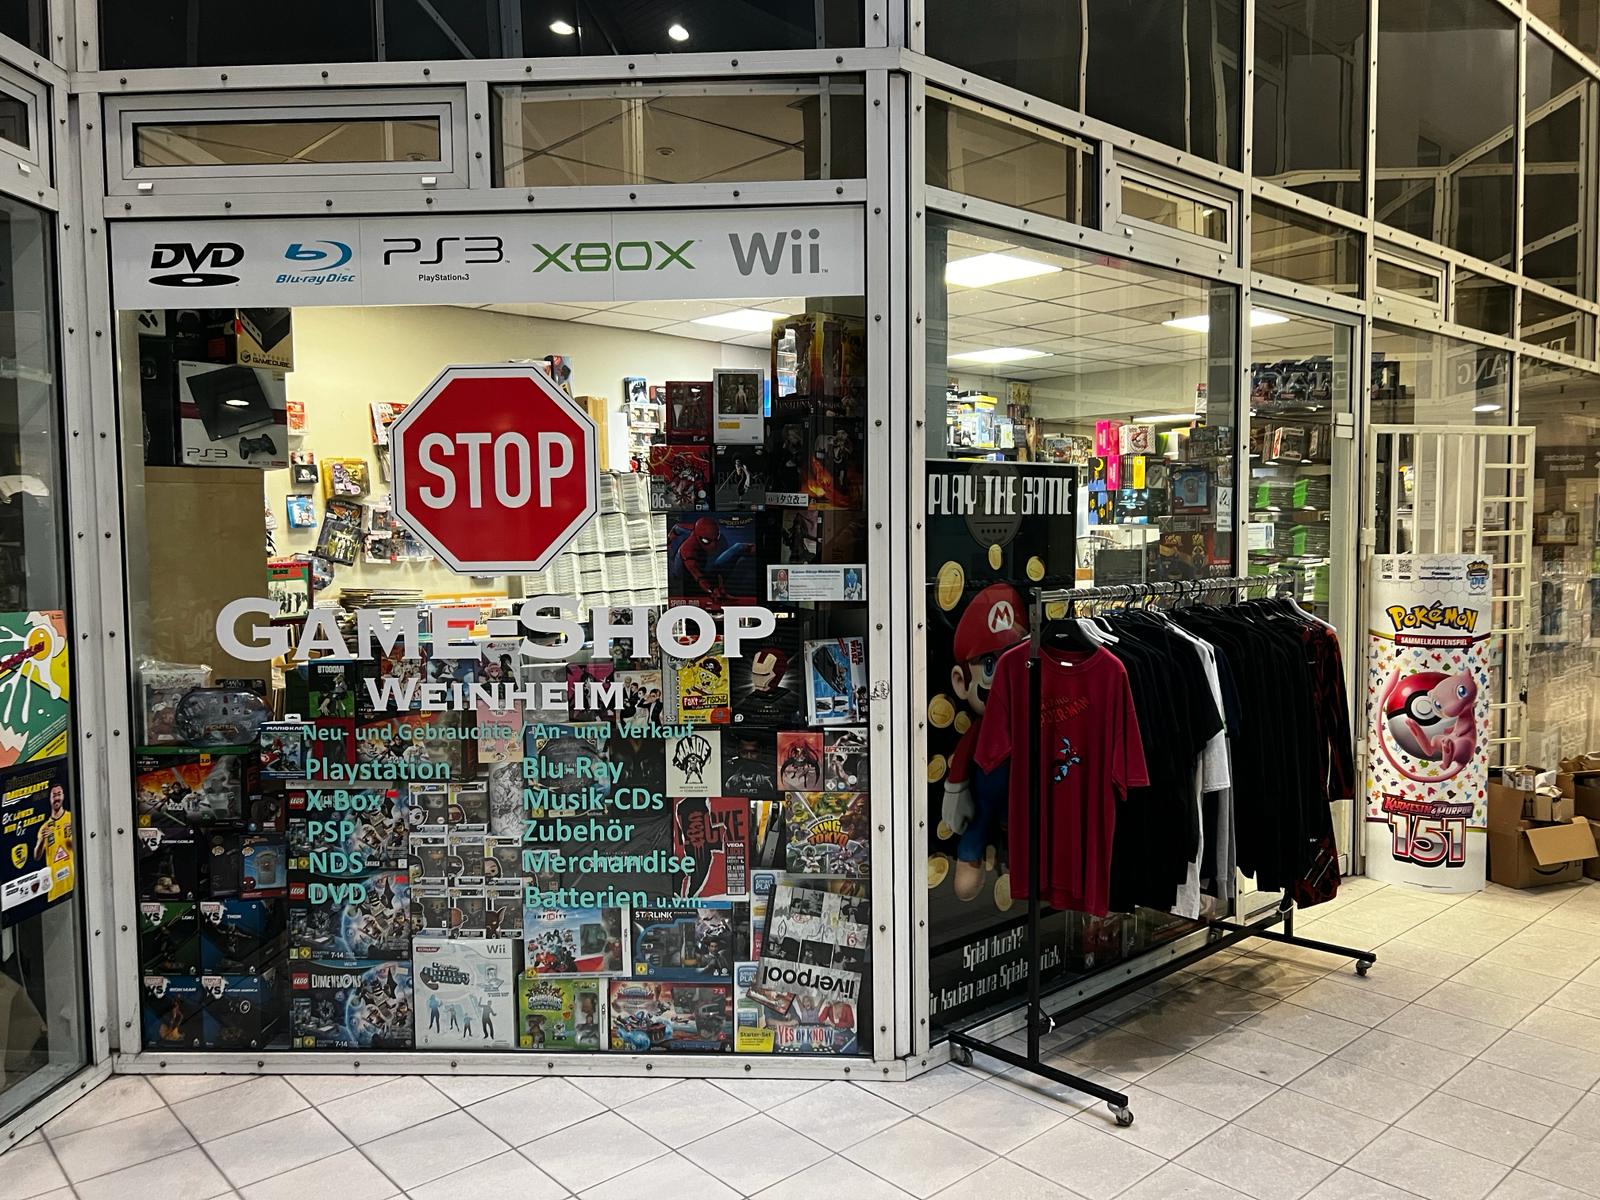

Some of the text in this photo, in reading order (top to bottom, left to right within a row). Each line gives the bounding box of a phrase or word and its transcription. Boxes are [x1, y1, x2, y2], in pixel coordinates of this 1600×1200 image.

[150, 242, 245, 273] DVD
[383, 236, 504, 265] PS3
[531, 239, 696, 272] XBOX
[728, 228, 820, 276] Wii
[252, 357, 292, 368] GAMECUBE
[187, 447, 228, 459] PS3
[418, 431, 574, 509] STOP
[928, 474, 1073, 515] PLAY THE GAME
[216, 594, 776, 662] GAME-SHOP
[1400, 636, 1468, 646] SAMMELKARTENSPIEL
[363, 677, 626, 712] WEINHEIM
[302, 723, 349, 741] Neu-
[355, 723, 392, 741] und
[398, 722, 512, 741] Gebrauchte
[534, 722, 567, 739] An-
[574, 721, 611, 739] und
[618, 720, 694, 739] Verkauf
[305, 756, 624, 784] Playstation Blu-Ray
[306, 788, 664, 812] X-Box Musik-CDs
[307, 818, 634, 843] PSP Zubehör
[811, 819, 842, 834] KING
[142, 837, 160, 847] VS
[807, 831, 850, 846] TOKYO
[1388, 812, 1466, 868] 151
[308, 849, 696, 874] NDS Merchandise
[290, 887, 305, 895] LEGO
[309, 882, 708, 909] DVD Batterien u.v.m.
[144, 912, 161, 922] VS
[204, 912, 220, 921] VS
[635, 911, 673, 919] STARLINK
[486, 944, 506, 954] Wii
[963, 925, 1024, 971] Spiel durch?
[311, 973, 362, 989] DIMENSIONS
[762, 965, 855, 1000] liverpool
[1000, 957, 1029, 990] Spiele
[147, 985, 164, 995] VS
[205, 986, 221, 996] VS
[739, 1030, 772, 1038] Starter-Set
[779, 1026, 795, 1044] YES
